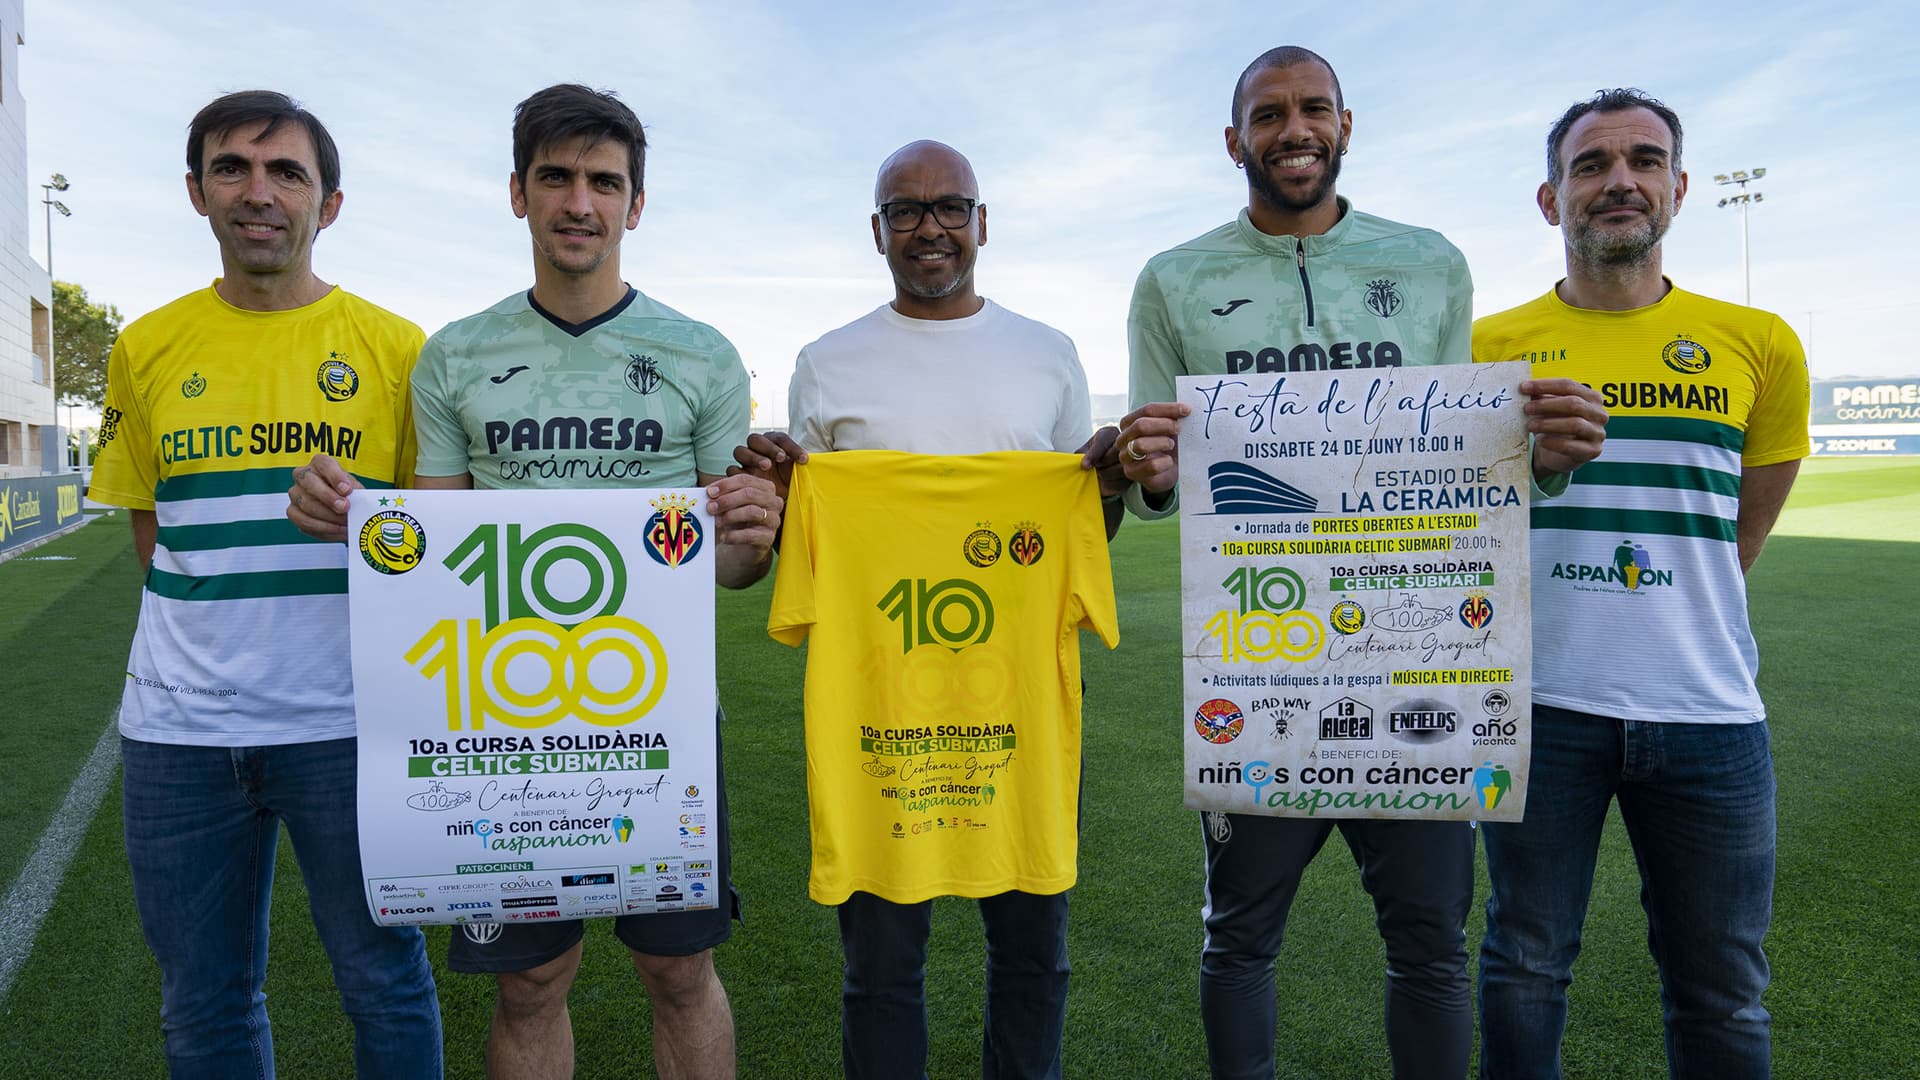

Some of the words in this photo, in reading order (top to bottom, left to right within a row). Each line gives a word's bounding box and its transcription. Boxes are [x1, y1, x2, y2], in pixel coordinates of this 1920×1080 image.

[1225, 341, 1402, 374] PAMESA
[1601, 382, 1729, 415] SUBMARI
[1833, 384, 1920, 405] PAME
[1195, 377, 1308, 439] Festa
[1317, 378, 1356, 432] de
[161, 425, 243, 465] CELTIC
[250, 421, 361, 460] SUBMARI
[485, 416, 664, 455] PAMESA
[1826, 439, 1896, 451] ZOOMEX
[1244, 441, 1316, 459] DISSABTE
[1321, 440, 1339, 456] 24
[1344, 439, 1363, 455] DE
[1368, 438, 1403, 454] JUNY
[1409, 436, 1449, 452] 18.00
[1455, 435, 1463, 451] H
[499, 454, 650, 480] cerámica
[1375, 469, 1455, 487] ESTADIO
[1463, 467, 1488, 483] DE
[1341, 492, 1375, 513] LA
[1383, 484, 1521, 511] CERÁMICA
[380, 511, 422, 535] VILA-REAL
[1244, 521, 1291, 534] Jornada
[1295, 521, 1309, 533] de
[1313, 520, 1359, 533] PORTES
[1363, 518, 1414, 532] OBERTES
[1417, 517, 1425, 530] A
[1428, 515, 1477, 529] L'ESTADI
[1222, 543, 1243, 556] 10a
[1247, 542, 1286, 555] CURSA
[1289, 539, 1350, 554] SOLIDÀRIA
[1355, 539, 1394, 554] CELTIC
[1398, 535, 1451, 552] SUBMARÍ
[1455, 536, 1487, 550] 20.00
[1330, 566, 1355, 577] 10a
[1358, 564, 1411, 576] CURSA
[1413, 560, 1493, 574] SOLIDÀRIA
[1343, 577, 1400, 590] CELTIC
[1389, 611, 1423, 628] 100
[1203, 609, 1326, 664] 100
[1327, 633, 1416, 661] Centenari
[1421, 630, 1497, 663] Groguet
[135, 677, 153, 687] ELTIC
[403, 615, 668, 731] 100
[1212, 674, 1266, 687] Activitats
[1270, 674, 1319, 688] lúdiques
[1323, 678, 1329, 686] a
[1334, 674, 1343, 686] la
[1348, 674, 1382, 688] gespa
[1386, 672, 1389, 684] i
[1393, 670, 1437, 685] MÚSICA
[1442, 671, 1456, 683] EN
[1461, 669, 1513, 683] DIRECTE:
[1251, 698, 1280, 712] BAD
[1283, 697, 1312, 711] WAY
[860, 725, 881, 739] 10a
[884, 727, 933, 740] CURSA
[936, 723, 1015, 737] SOLIDÀRIA
[1389, 712, 1456, 734] ENFIELDS
[409, 738, 448, 755] 10a
[455, 736, 535, 754] CURSA
[542, 730, 668, 751] SOLIDÀRIA
[872, 741, 925, 755] CELTIC
[1472, 738, 1517, 746] vicente
[1308, 751, 1318, 760] A
[1321, 750, 1379, 760] BENEFICI
[1382, 750, 1402, 759] DE:
[431, 755, 522, 777] CELTIC
[900, 756, 962, 782] Centenari
[1299, 766, 1353, 784] con
[1365, 761, 1473, 785] cáncer
[478, 779, 581, 811] Centenari
[585, 774, 671, 811] Groguet
[919, 785, 936, 797] con
[940, 782, 981, 795] cáncer
[420, 794, 448, 808] 100
[908, 795, 981, 814] aspanion
[1267, 788, 1470, 816] aspanion
[509, 821, 542, 833] con
[549, 816, 611, 831] cáncer
[491, 832, 612, 854] aspanion
[459, 863, 531, 873] PATROCINEN:
[500, 880, 553, 889] COVALCA
[380, 907, 435, 916] FULGOR
